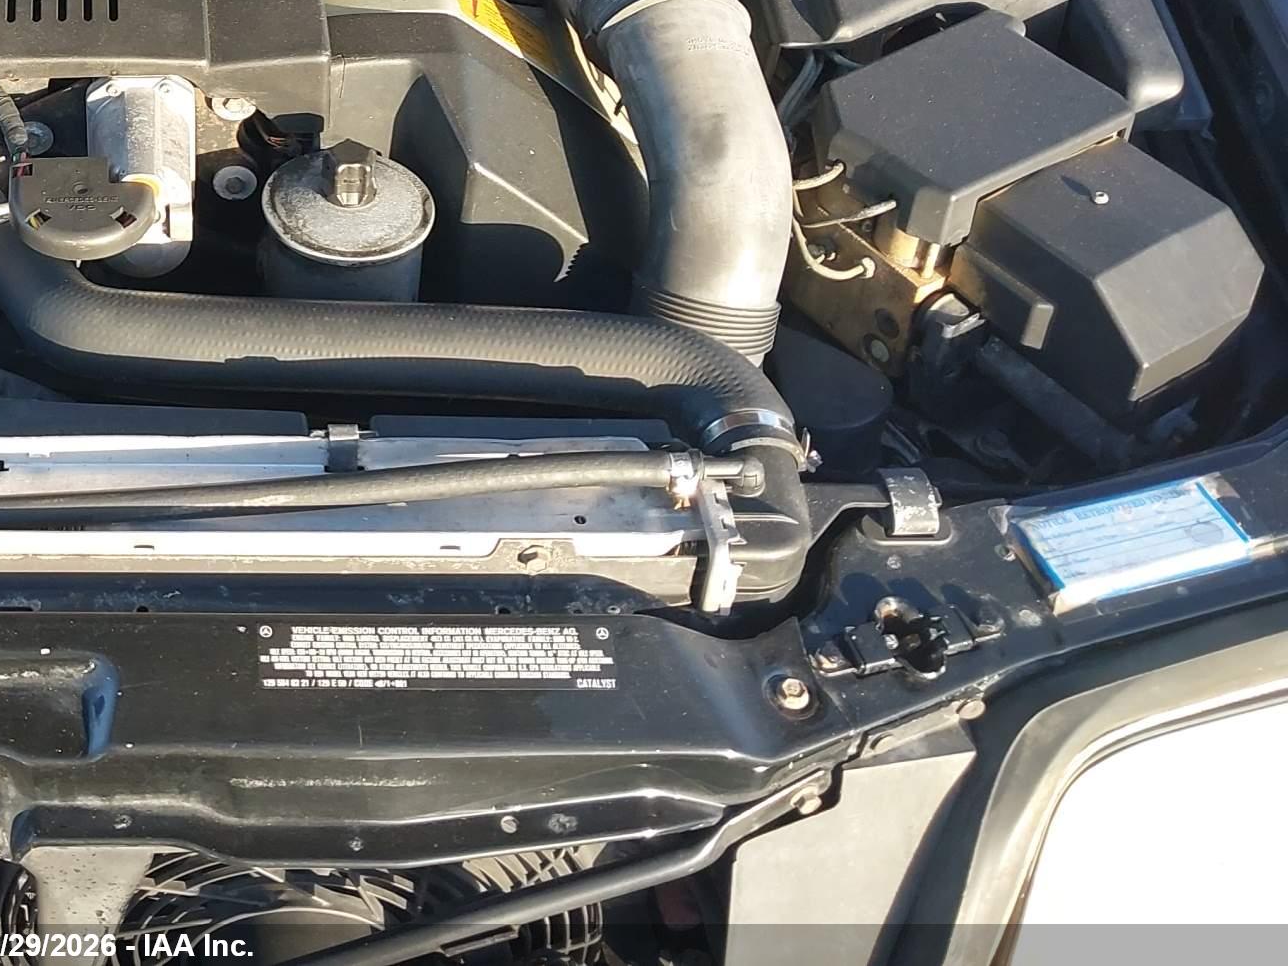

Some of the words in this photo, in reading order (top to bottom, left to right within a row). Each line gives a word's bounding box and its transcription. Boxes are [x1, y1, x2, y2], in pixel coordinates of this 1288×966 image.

[331, 627, 375, 635] EMISSION
[378, 627, 419, 635] CONTROL
[422, 627, 481, 635] INFORMATION
[484, 627, 560, 635] MERCEDES-BENZ
[576, 678, 617, 689] CATALYST
